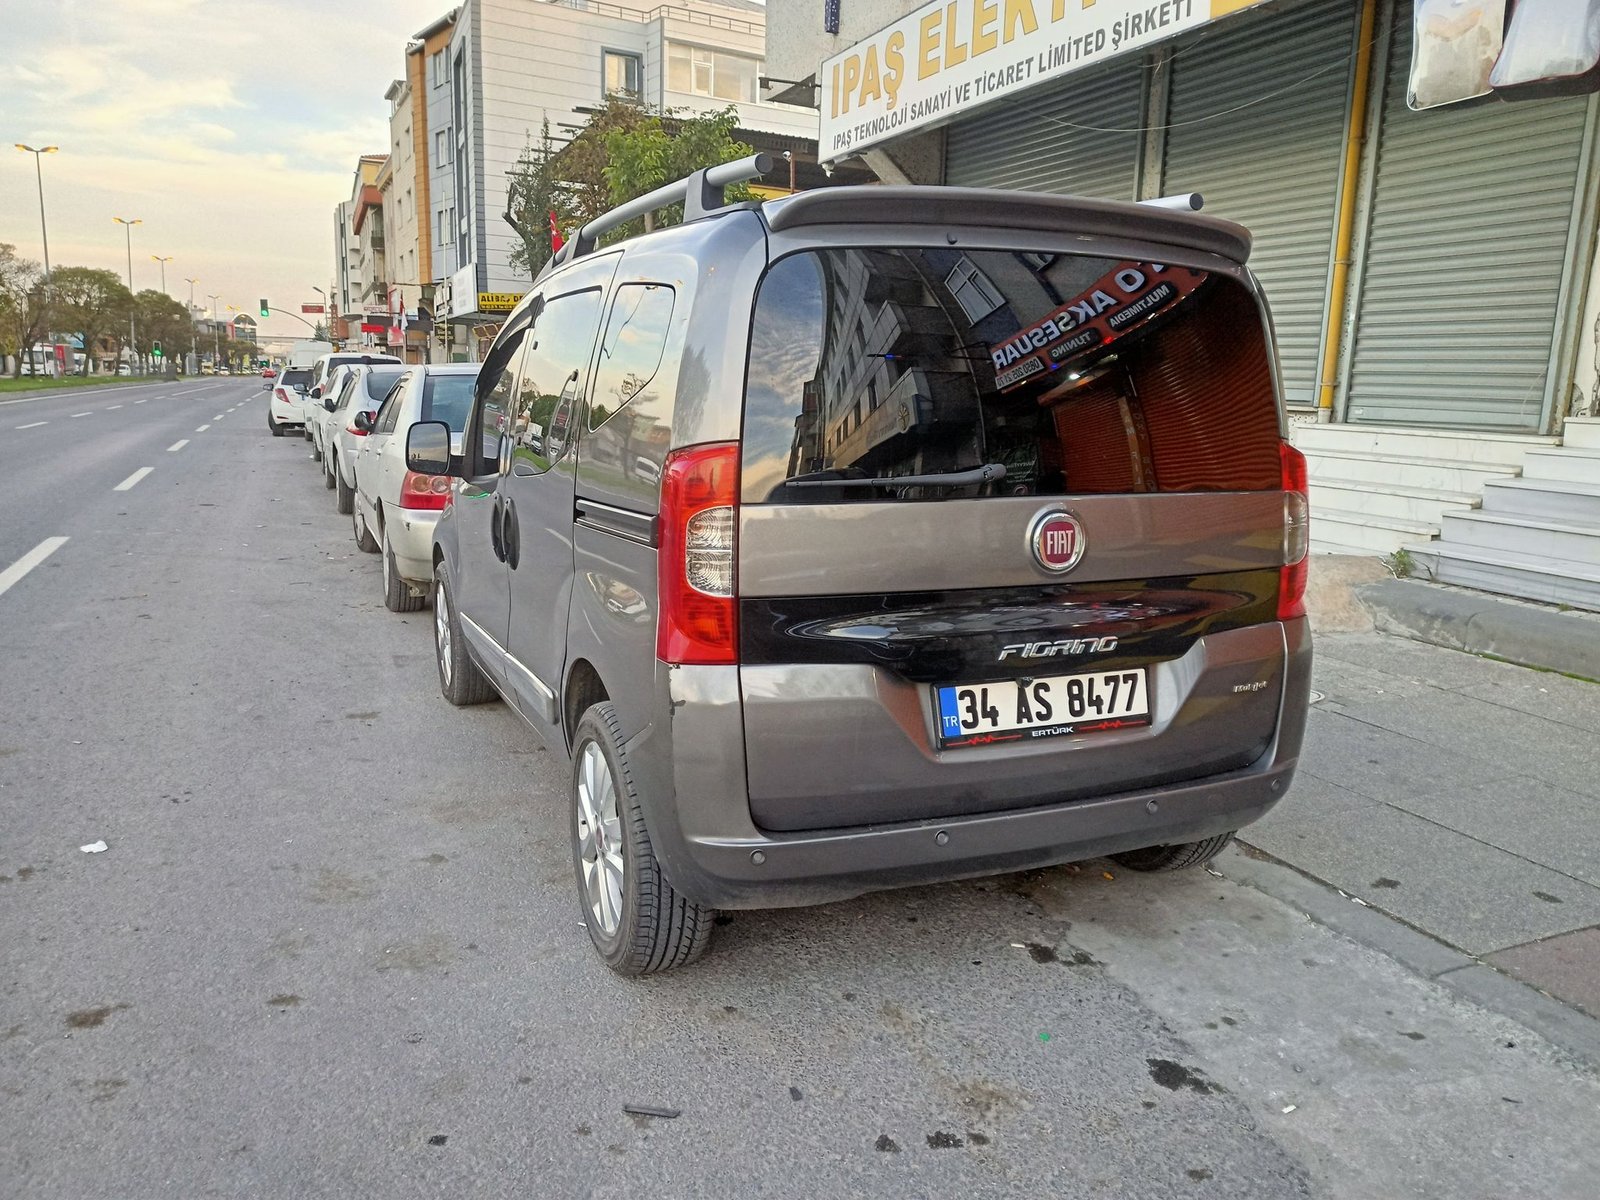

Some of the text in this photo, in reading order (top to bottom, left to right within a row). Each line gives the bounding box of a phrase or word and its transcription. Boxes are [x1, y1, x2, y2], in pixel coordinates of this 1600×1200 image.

[831, 30, 905, 119] IPAŞ
[833, 129, 852, 149] IPAŞ
[854, 102, 908, 142] TEKNOLOJİ
[910, 85, 952, 120] SANAYİ
[955, 82, 971, 104] VE
[975, 56, 1035, 97] TİCARET
[1038, 28, 1106, 73] LİMİTED
[1046, 530, 1073, 555] FIAT
[998, 636, 1119, 661] FIORINO
[943, 672, 1139, 730] TR 34 AS 8477
[1031, 725, 1074, 738] ERTÜRK
